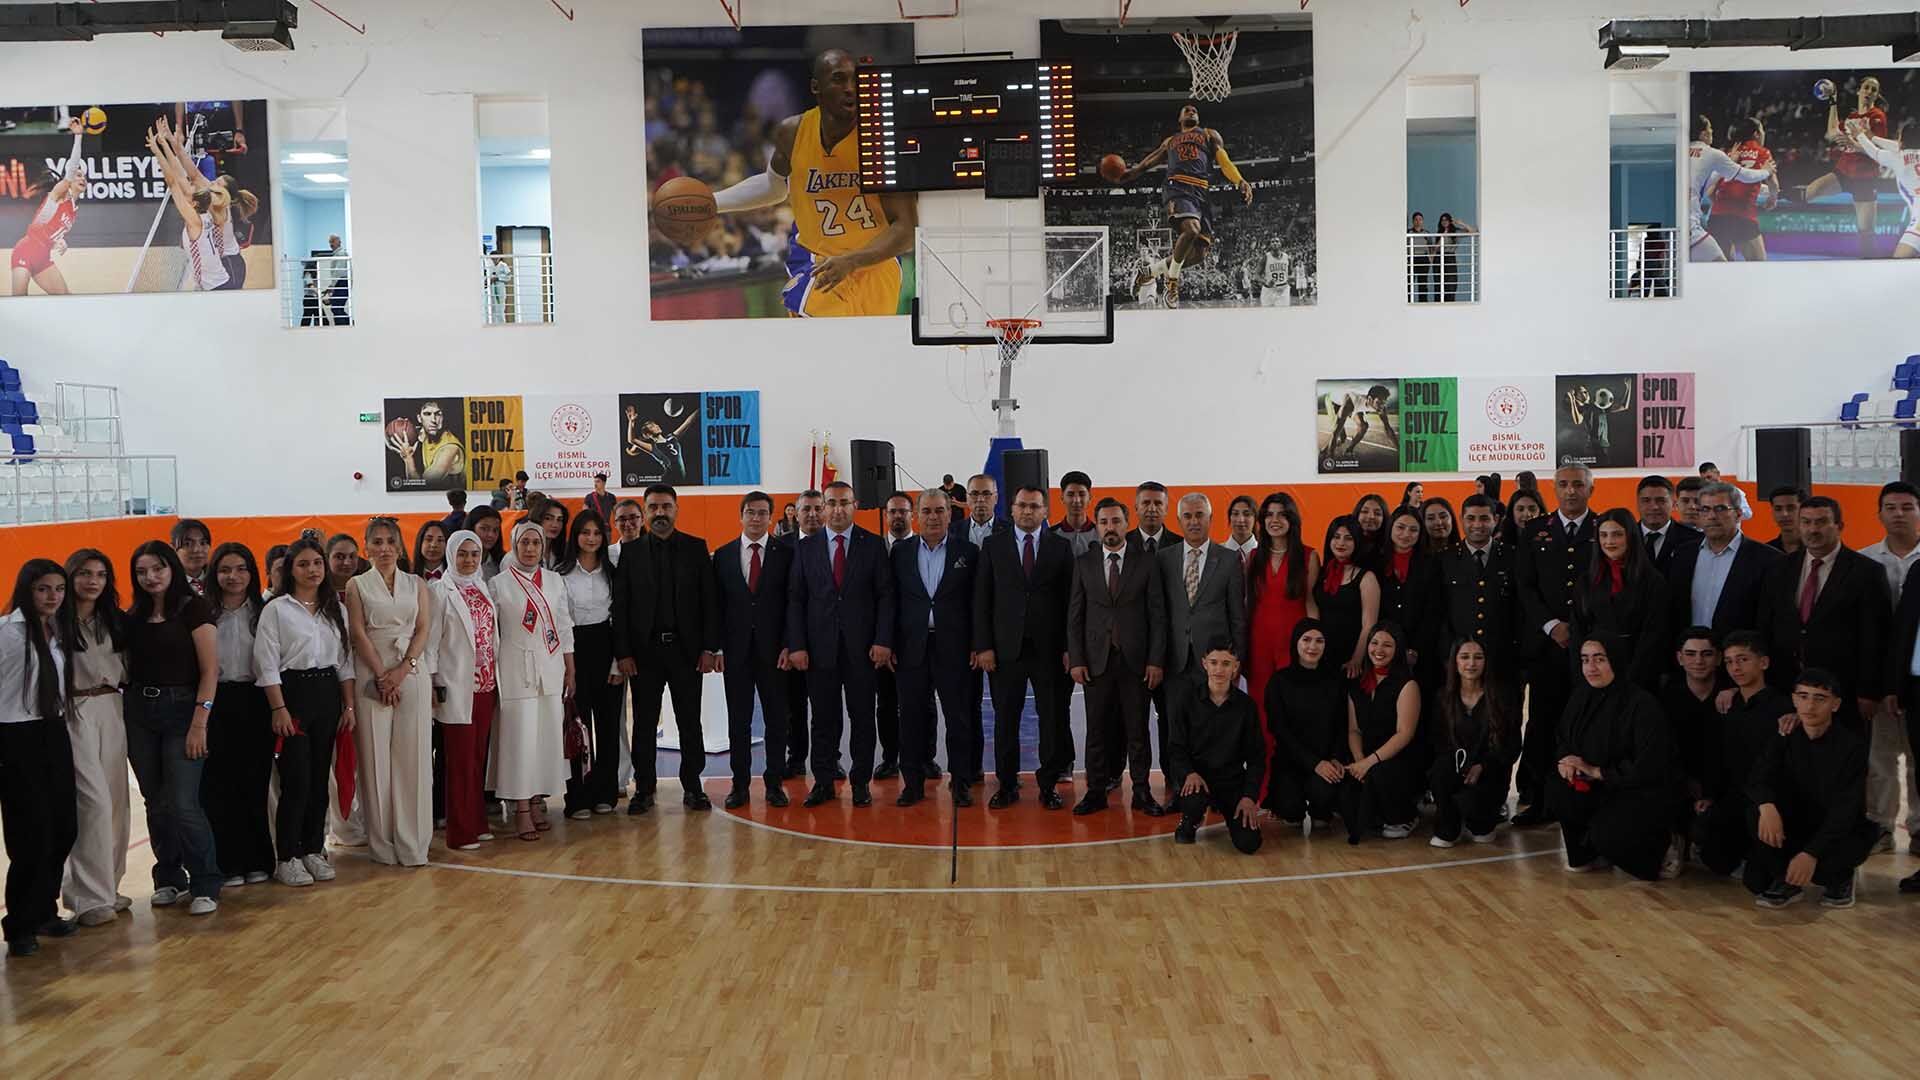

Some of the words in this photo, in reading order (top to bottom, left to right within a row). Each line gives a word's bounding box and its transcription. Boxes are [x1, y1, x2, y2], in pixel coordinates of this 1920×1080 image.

[959, 93, 973, 102] TIME
[806, 168, 861, 193] LAKER
[815, 194, 877, 237] 24
[1404, 382, 1440, 406] SPOR
[1642, 377, 1678, 401] SPOR
[469, 400, 505, 424] SPOR
[706, 395, 742, 419] SPOR
[1470, 443, 1507, 452] GENÇLİK
[1508, 443, 1520, 451] VE
[1521, 442, 1545, 450] SPOR
[1492, 432, 1521, 441] BİSMİL
[1642, 432, 1665, 459] BİZ
[557, 451, 587, 460] BİSMİL
[666, 443, 678, 456] 3
[1404, 437, 1427, 463] BİZ
[1468, 452, 1487, 462] İLÇE
[1488, 452, 1546, 461] MÜDÜRLÜĞÜ
[471, 456, 494, 481] BİZ
[534, 471, 553, 480] İLÇE
[535, 461, 573, 470] GENÇLİK
[574, 461, 586, 469] VE
[586, 461, 610, 469] SPOR
[707, 451, 730, 477] BİZ
